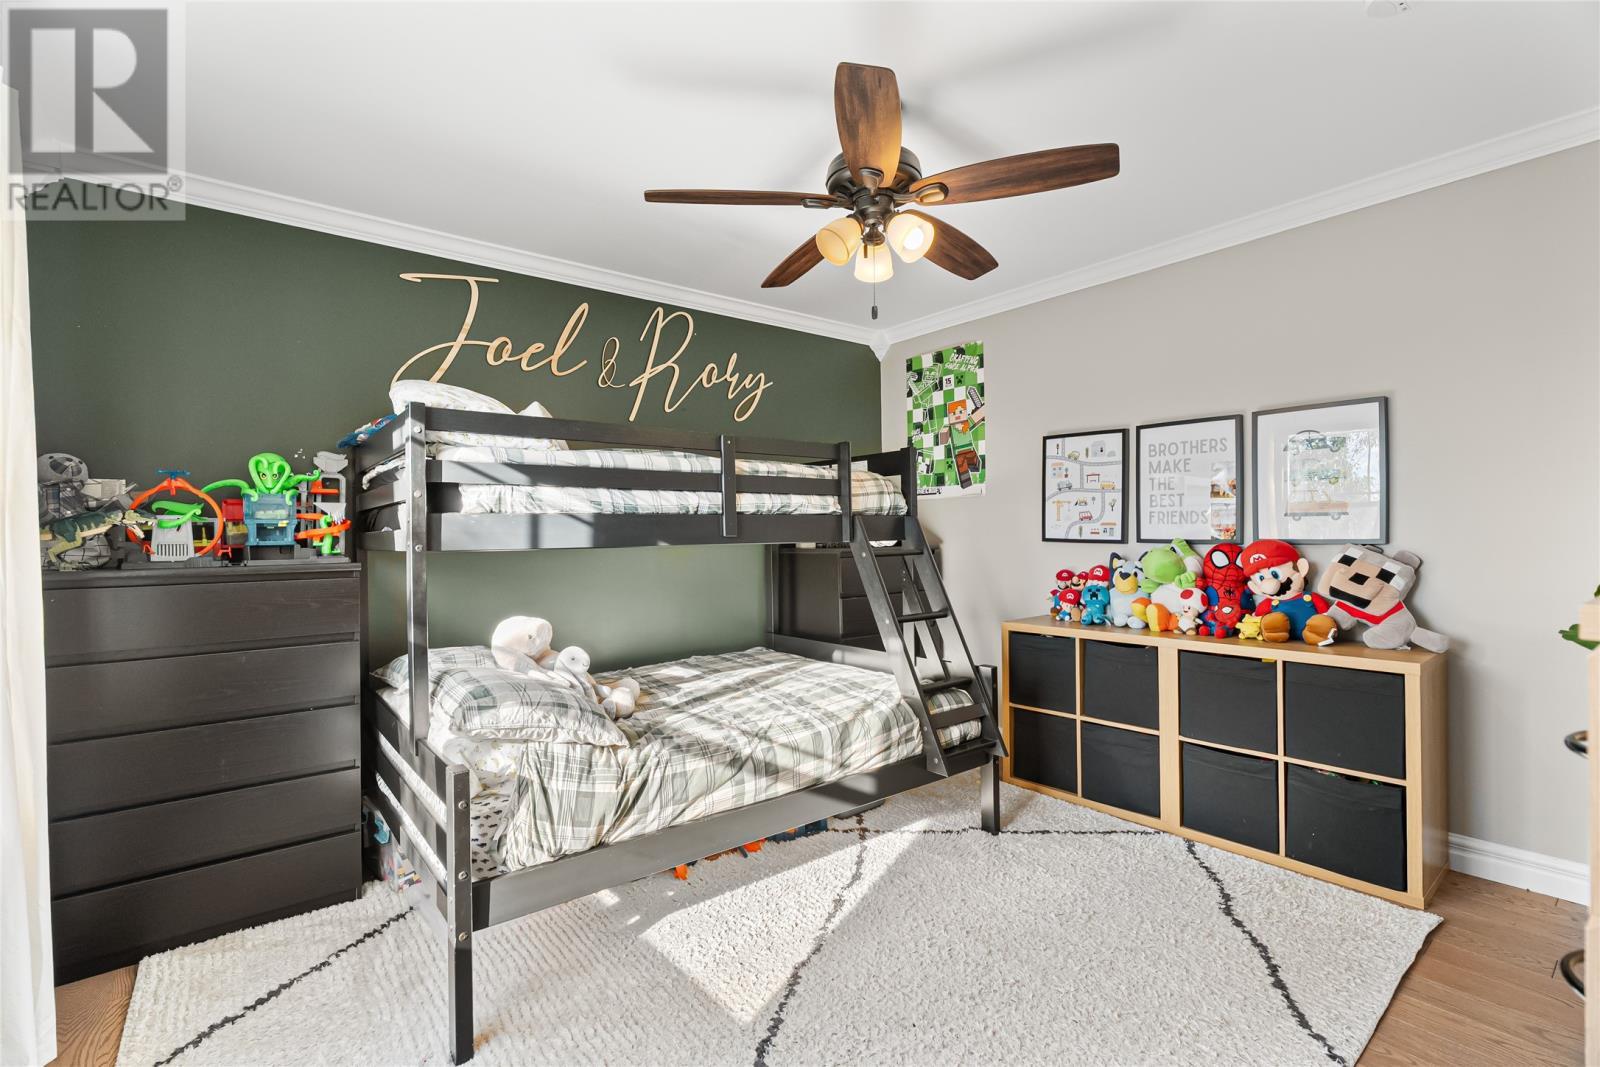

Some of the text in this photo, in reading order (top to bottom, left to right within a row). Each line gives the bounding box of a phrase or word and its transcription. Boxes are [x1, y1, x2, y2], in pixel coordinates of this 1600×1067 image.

[390, 273, 774, 423] Joel & Rory
[945, 377, 952, 385] 15
[1148, 438, 1228, 458] BROTHERS
[1148, 458, 1191, 474] MAKE
[1149, 477, 1175, 491] THE
[1149, 493, 1185, 508] BEST
[1148, 510, 1209, 525] FRIENDS
